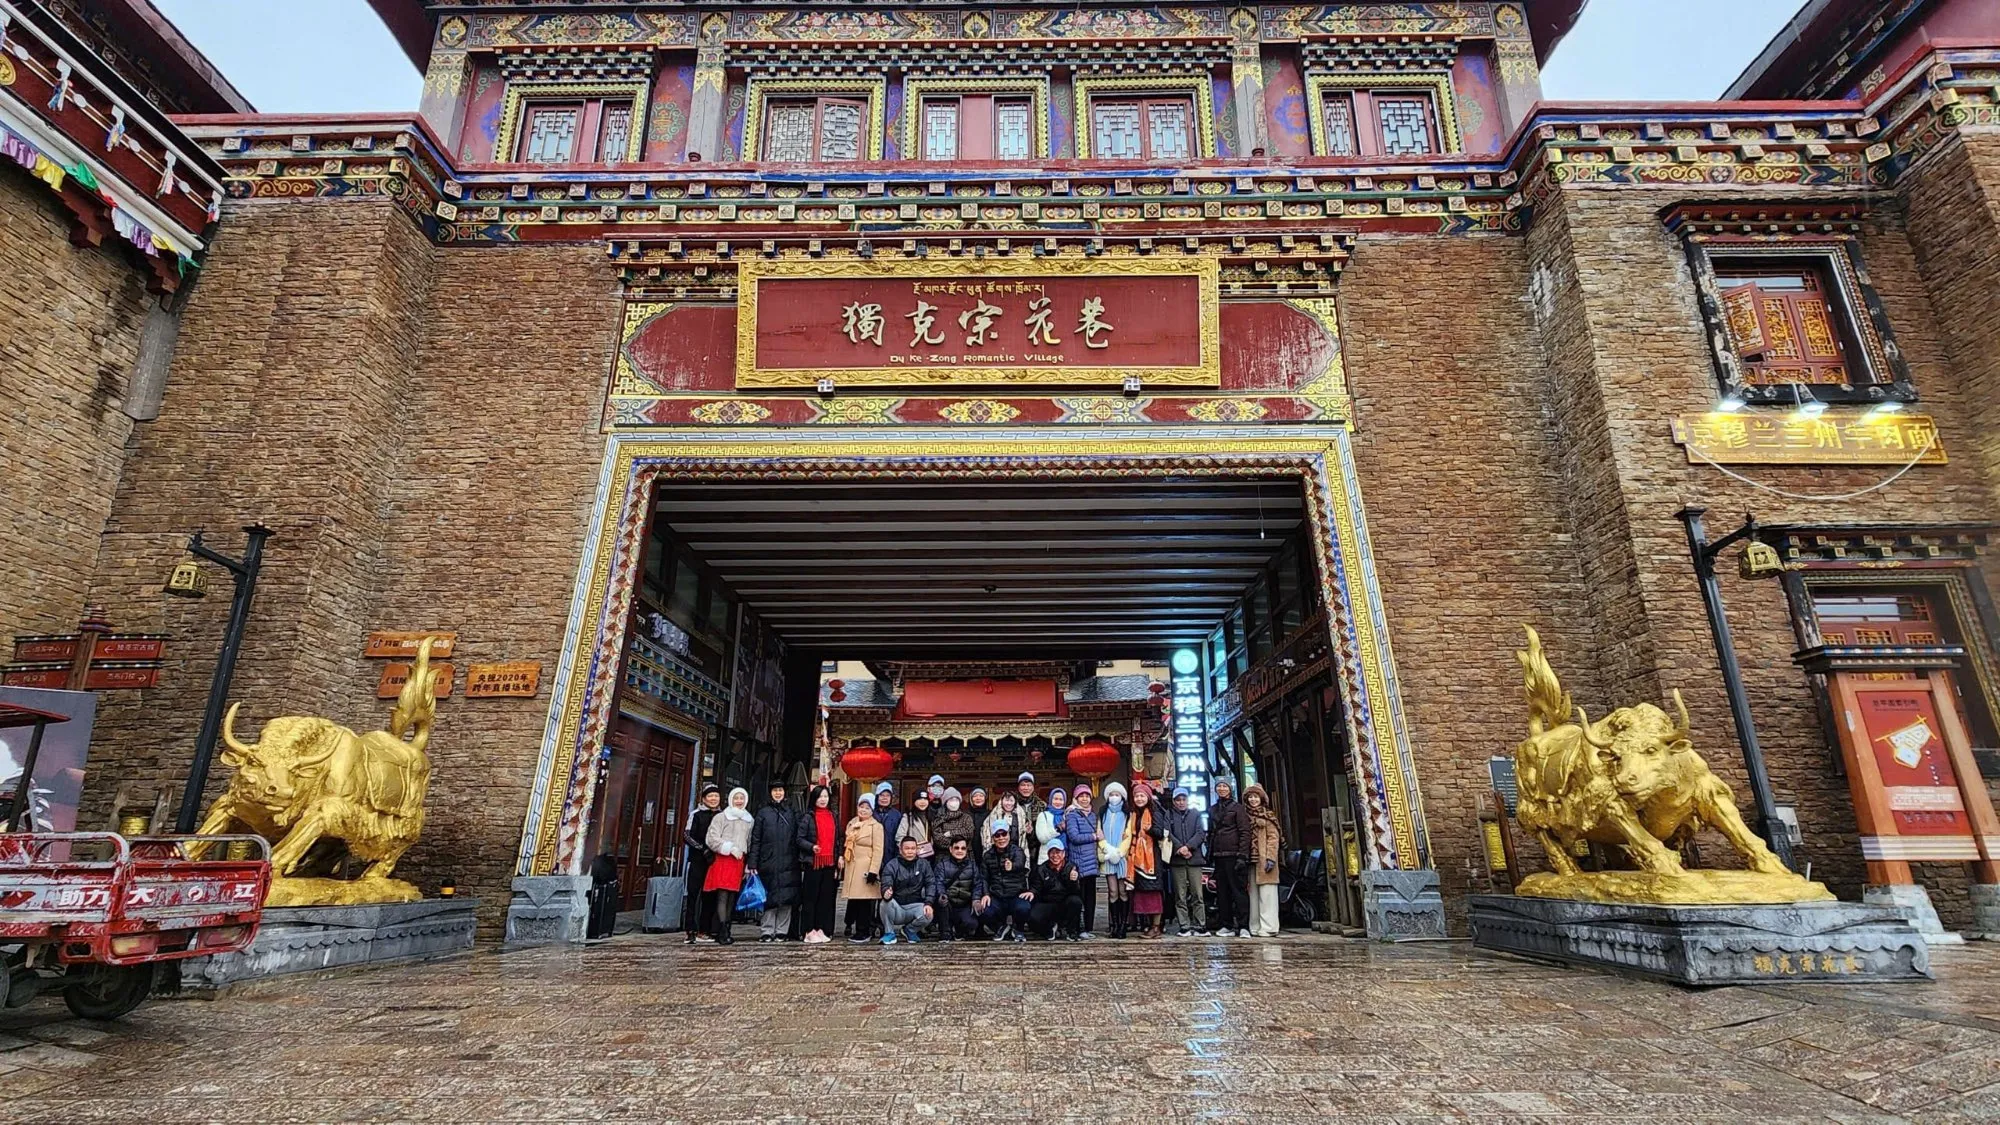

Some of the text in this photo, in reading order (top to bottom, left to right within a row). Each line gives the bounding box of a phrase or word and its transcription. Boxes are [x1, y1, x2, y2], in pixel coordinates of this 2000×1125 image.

[842, 296, 1114, 349] 獨克宗花巷
[963, 354, 1016, 362] Romantic
[1023, 354, 1064, 364] Village
